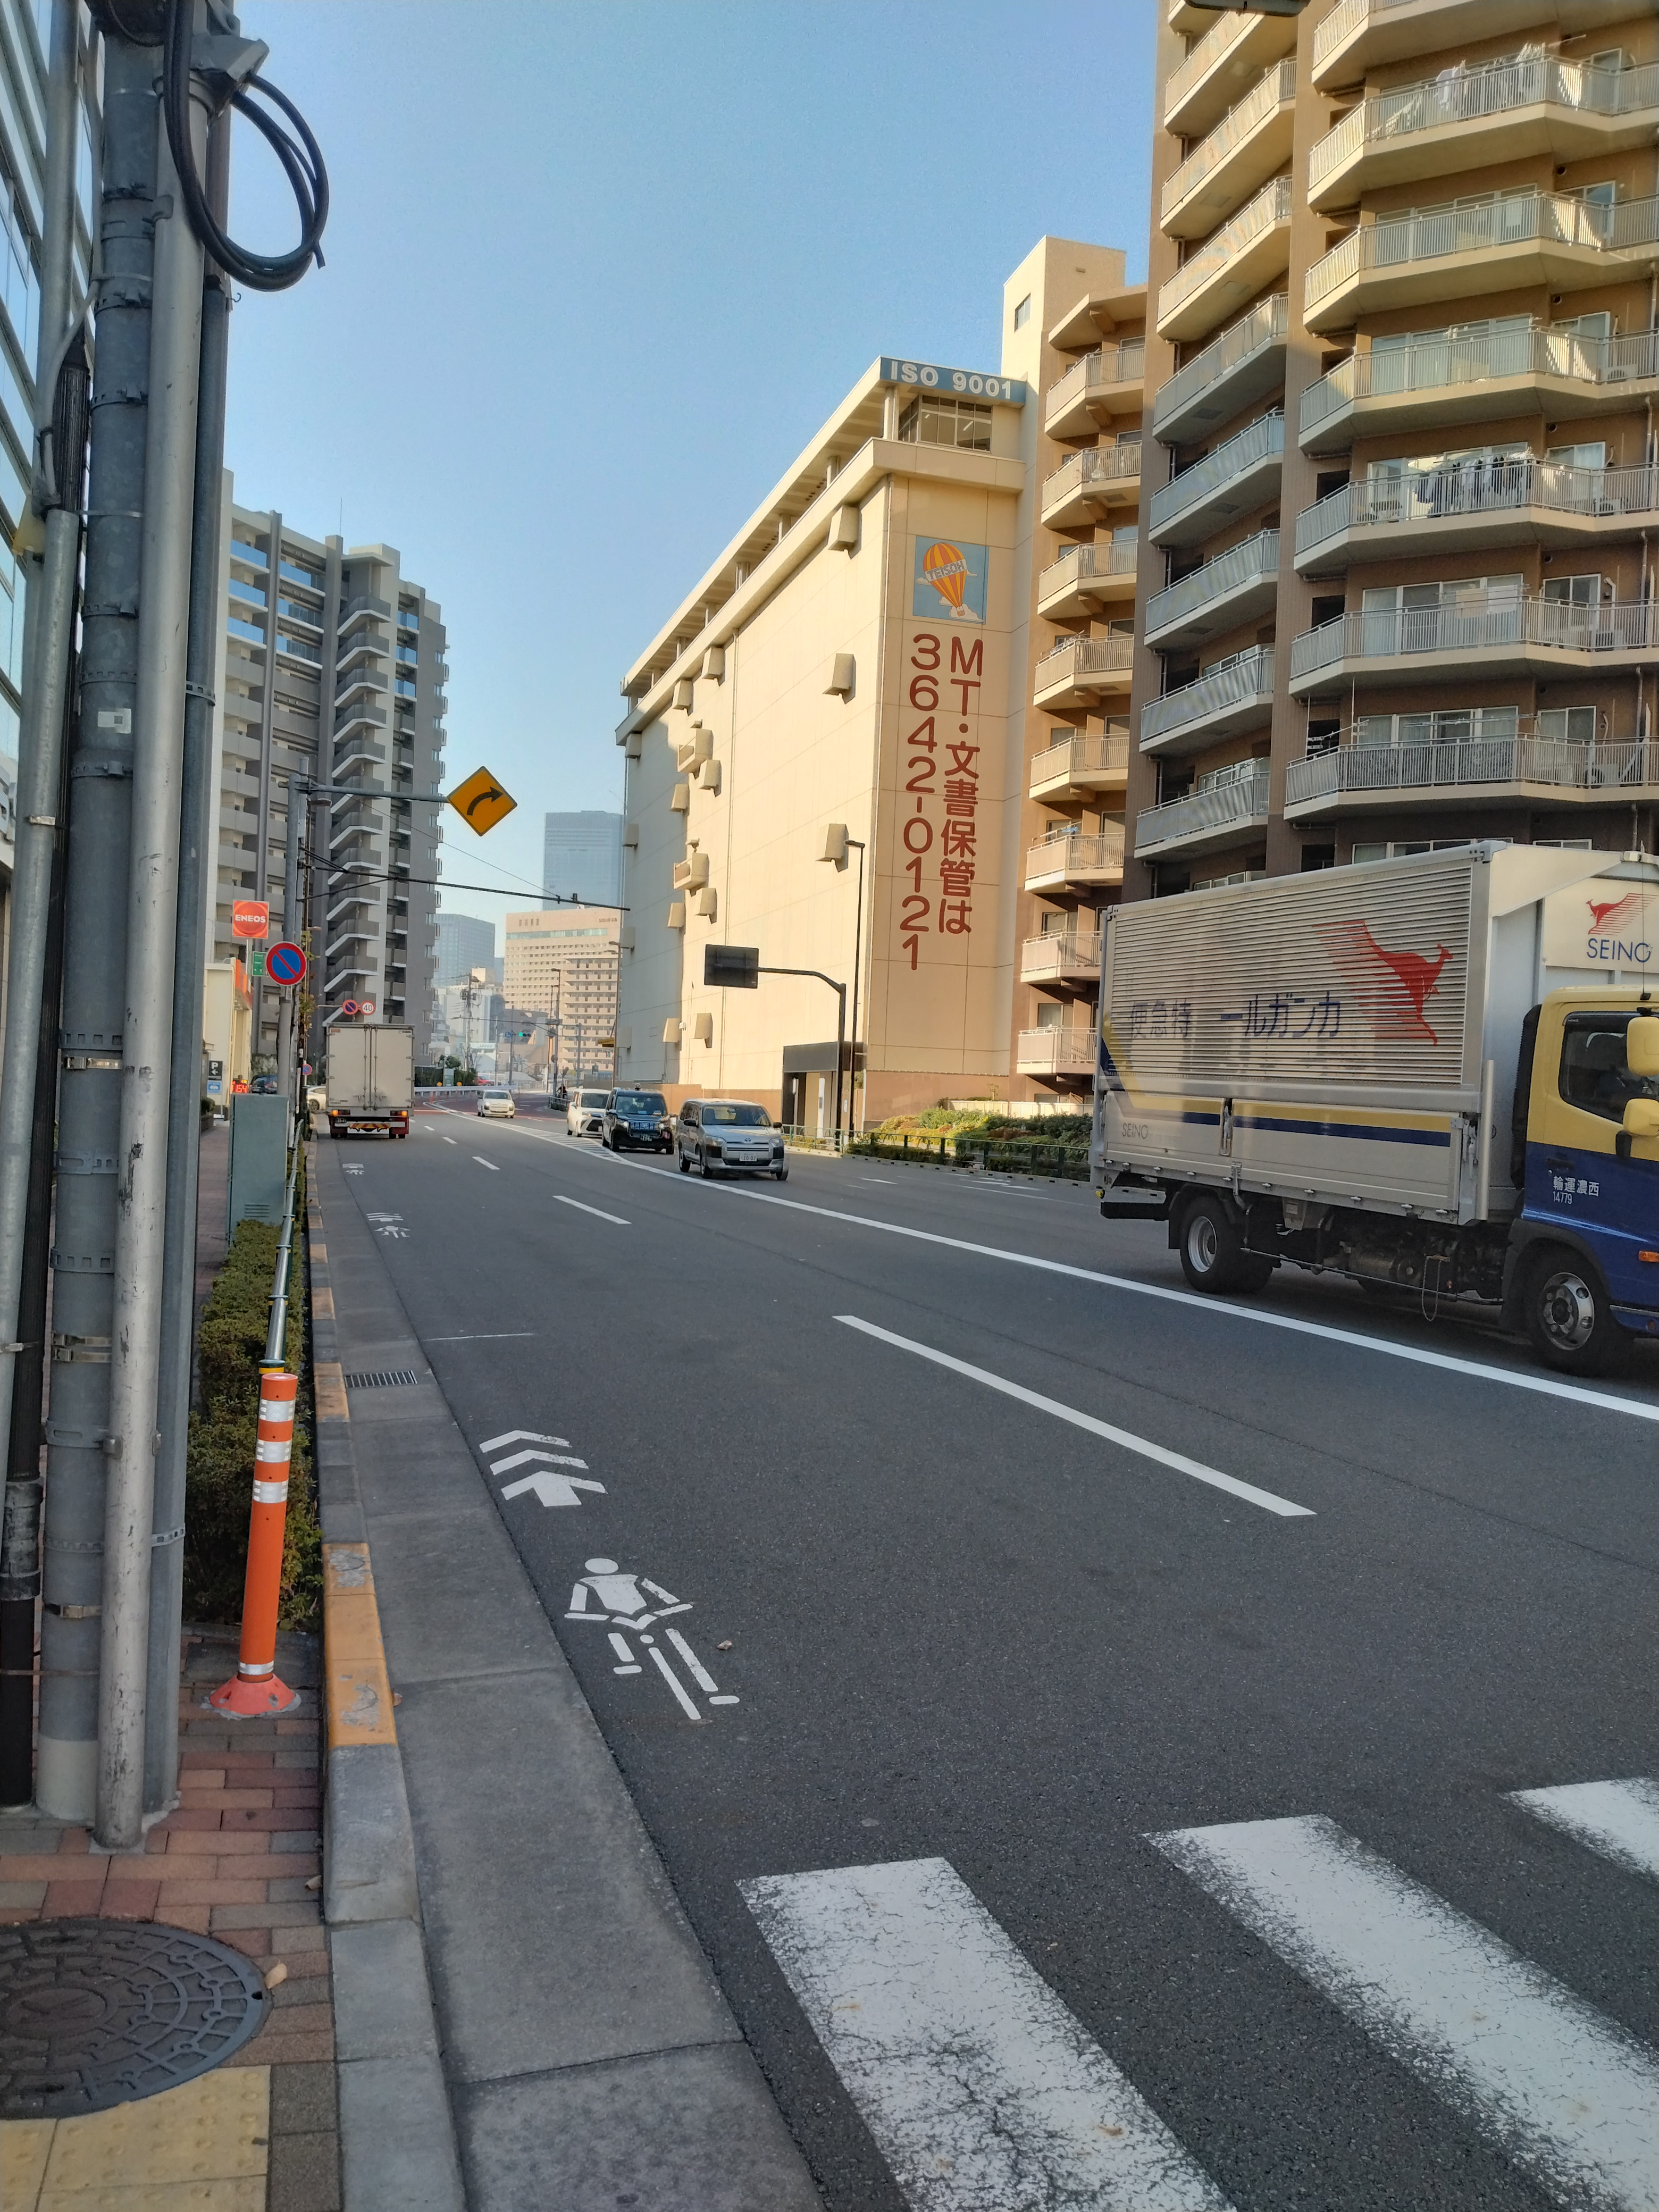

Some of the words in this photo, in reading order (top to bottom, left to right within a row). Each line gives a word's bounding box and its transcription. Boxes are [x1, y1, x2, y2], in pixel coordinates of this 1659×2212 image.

[890, 360, 939, 387] ISO
[952, 372, 1012, 400] 9001
[926, 560, 966, 581] TEISOH
[235, 914, 266, 923] ENEOS
[1586, 937, 1652, 963] SEINO
[1121, 1122, 1149, 1139] SEINO
[1553, 1191, 1572, 1205] 14779
